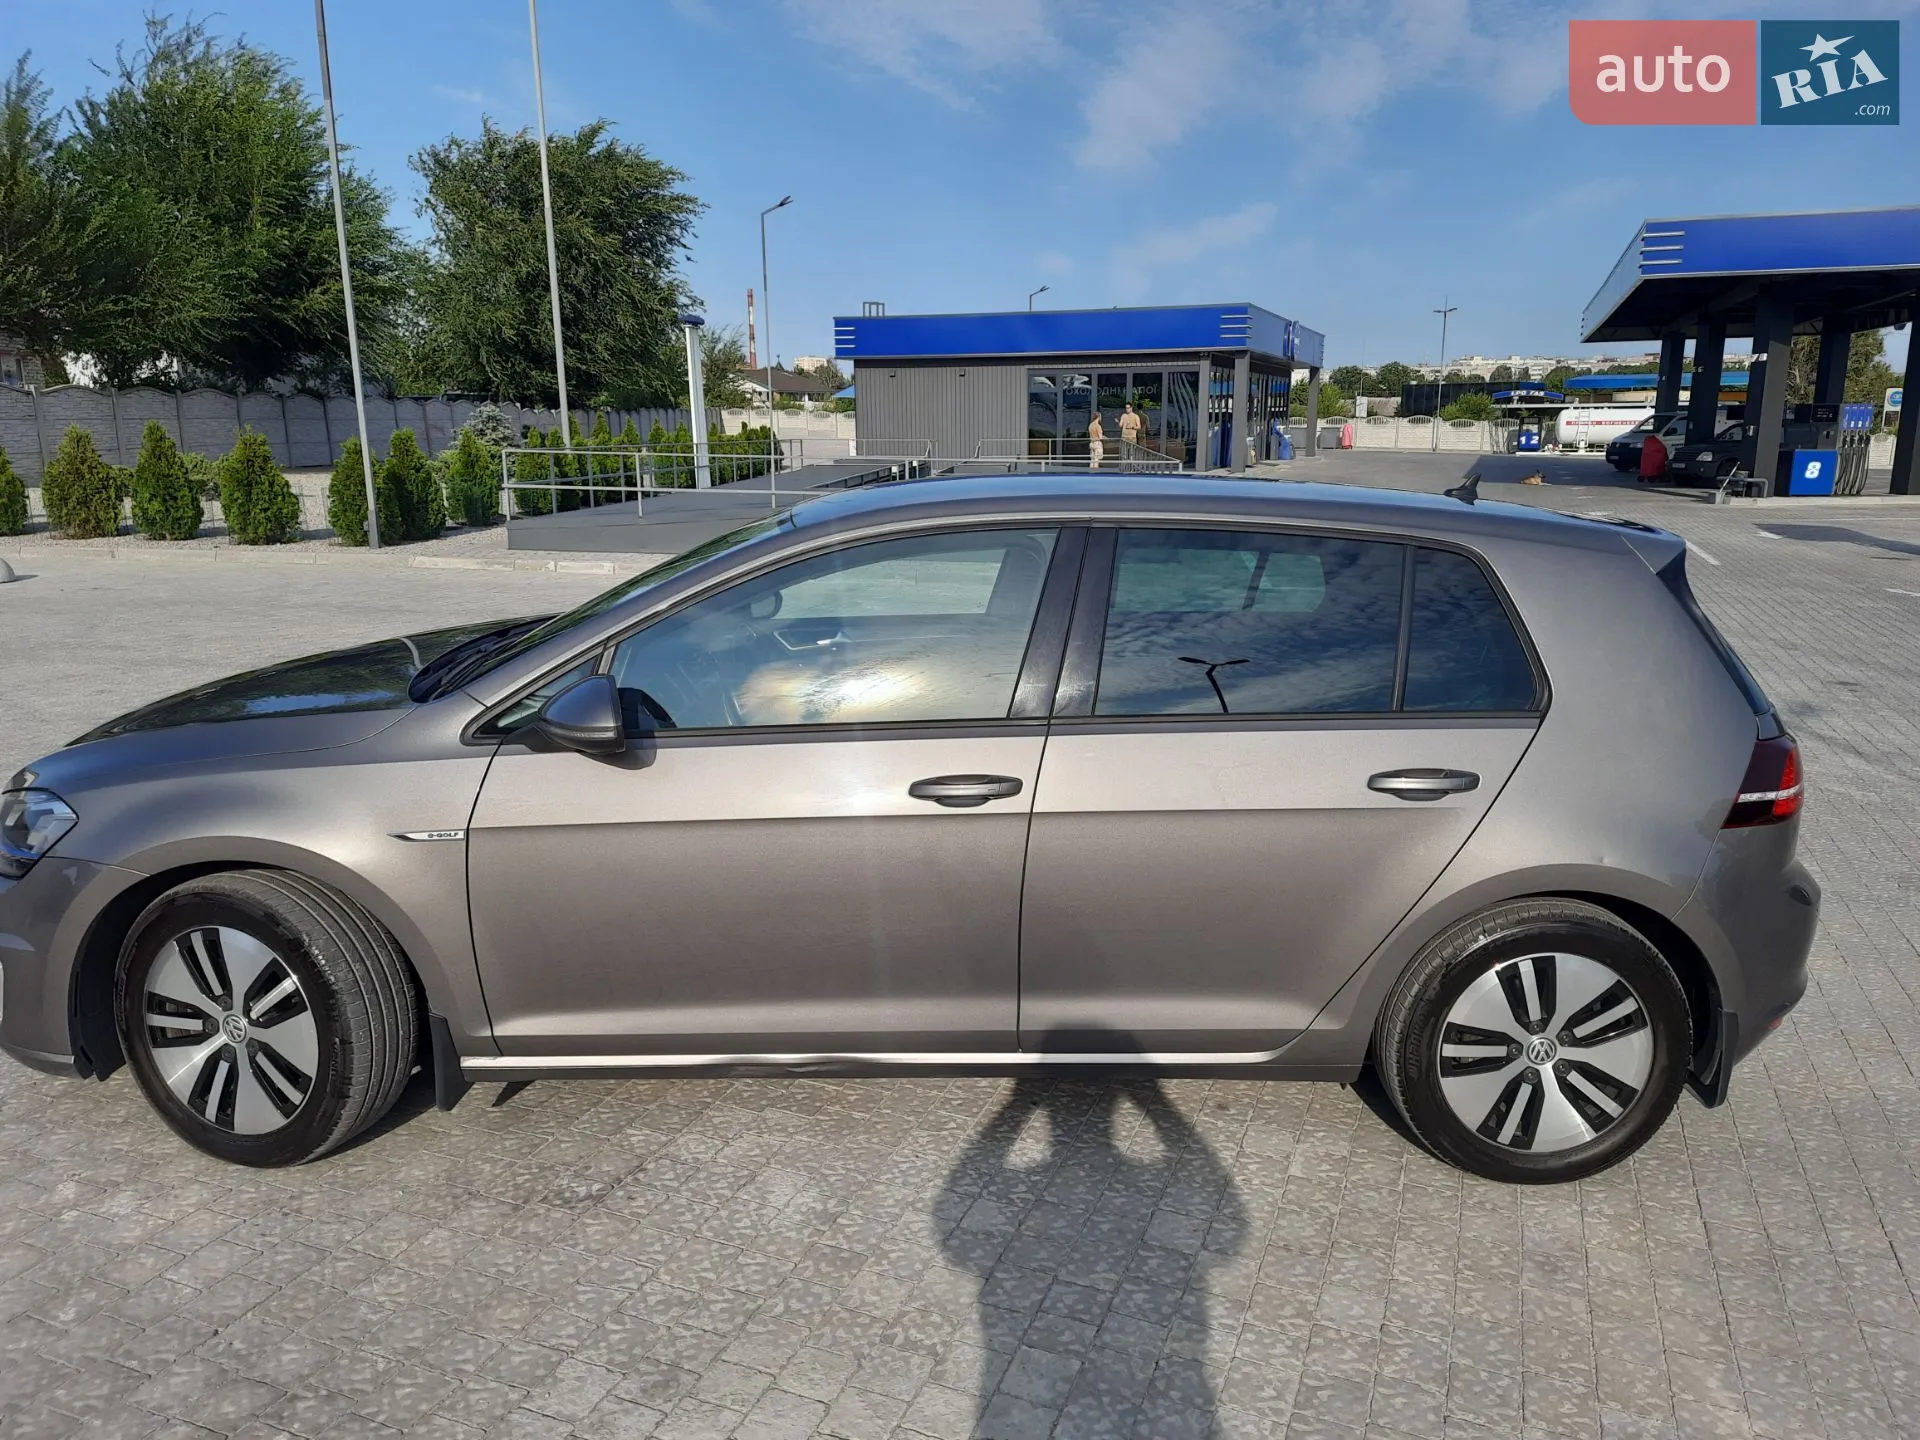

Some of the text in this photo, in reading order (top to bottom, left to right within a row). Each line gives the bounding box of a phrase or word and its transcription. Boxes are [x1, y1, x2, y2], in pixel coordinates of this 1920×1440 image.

[1519, 435, 1539, 444] 1 2
[1804, 461, 1822, 479] 8
